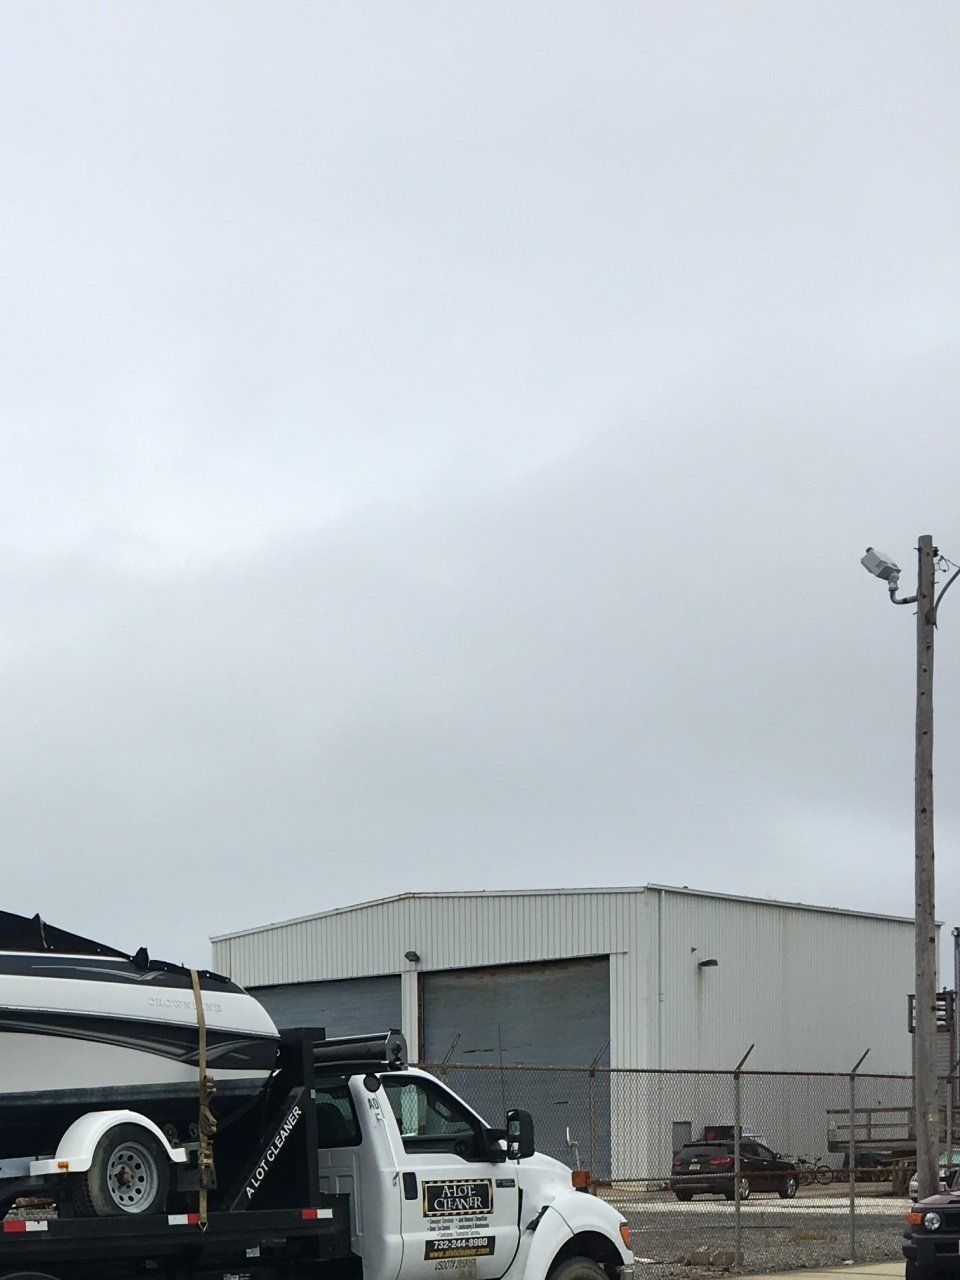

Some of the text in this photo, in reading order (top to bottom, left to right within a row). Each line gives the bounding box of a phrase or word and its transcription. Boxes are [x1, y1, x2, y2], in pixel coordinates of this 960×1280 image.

[246, 1105, 302, 1199] A LOT CLEANER
[434, 1196, 483, 1211] CLEANER
